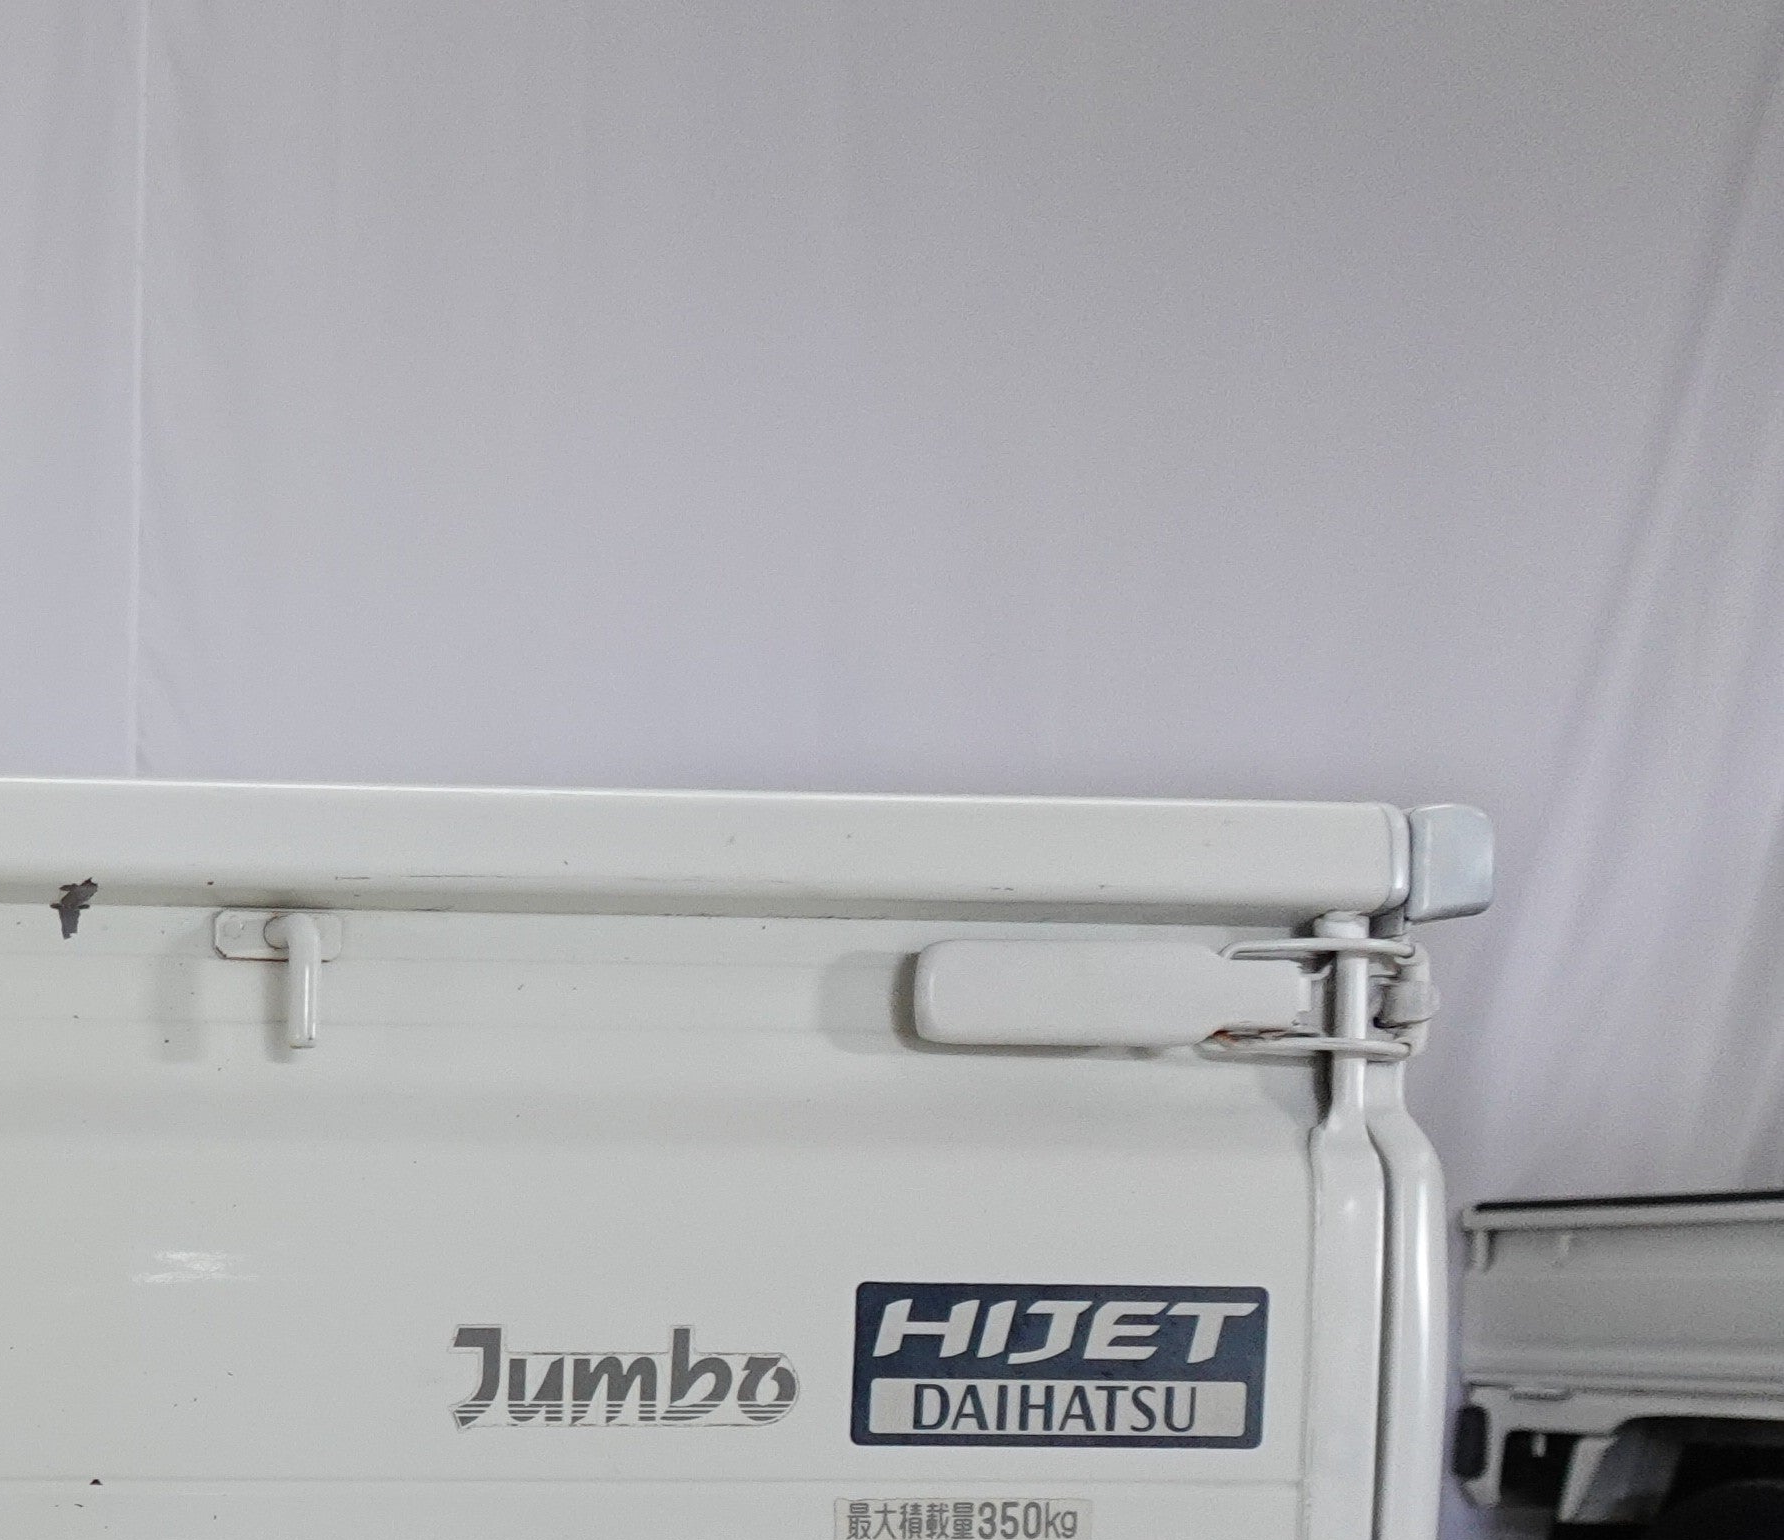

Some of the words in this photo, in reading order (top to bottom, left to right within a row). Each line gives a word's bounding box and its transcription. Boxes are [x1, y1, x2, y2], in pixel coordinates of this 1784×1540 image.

[871, 1297, 1261, 1366] HIJET
[448, 1326, 799, 1430] Jumbo
[912, 1383, 1199, 1434] DAIHATSU
[845, 1501, 1079, 1540] 最大積載量350kg
